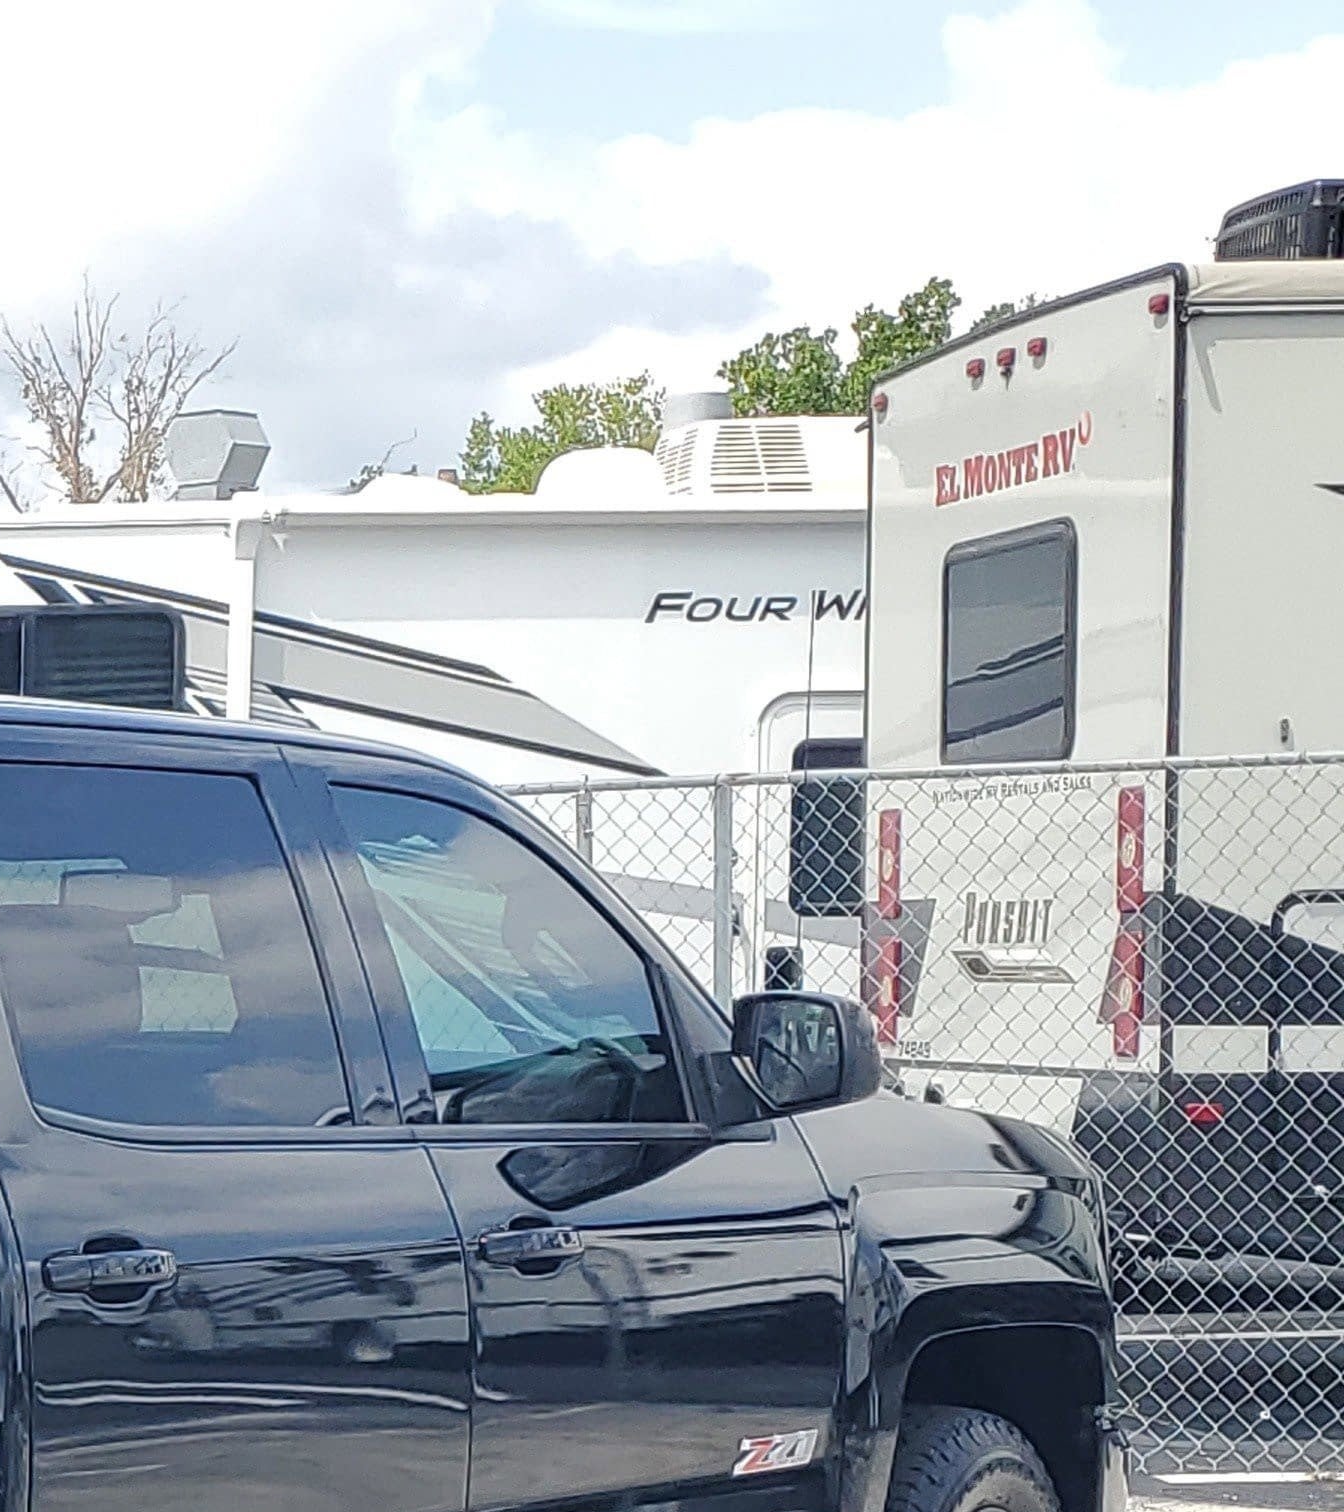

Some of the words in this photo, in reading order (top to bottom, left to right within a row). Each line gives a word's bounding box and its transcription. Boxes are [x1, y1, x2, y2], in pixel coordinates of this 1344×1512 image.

[935, 464, 961, 507] EL
[963, 443, 1039, 500] MONTE
[1042, 427, 1076, 478] RV
[644, 591, 798, 624] FOUR
[962, 891, 1054, 944] PURSUIT
[733, 1428, 818, 1476] Z71
